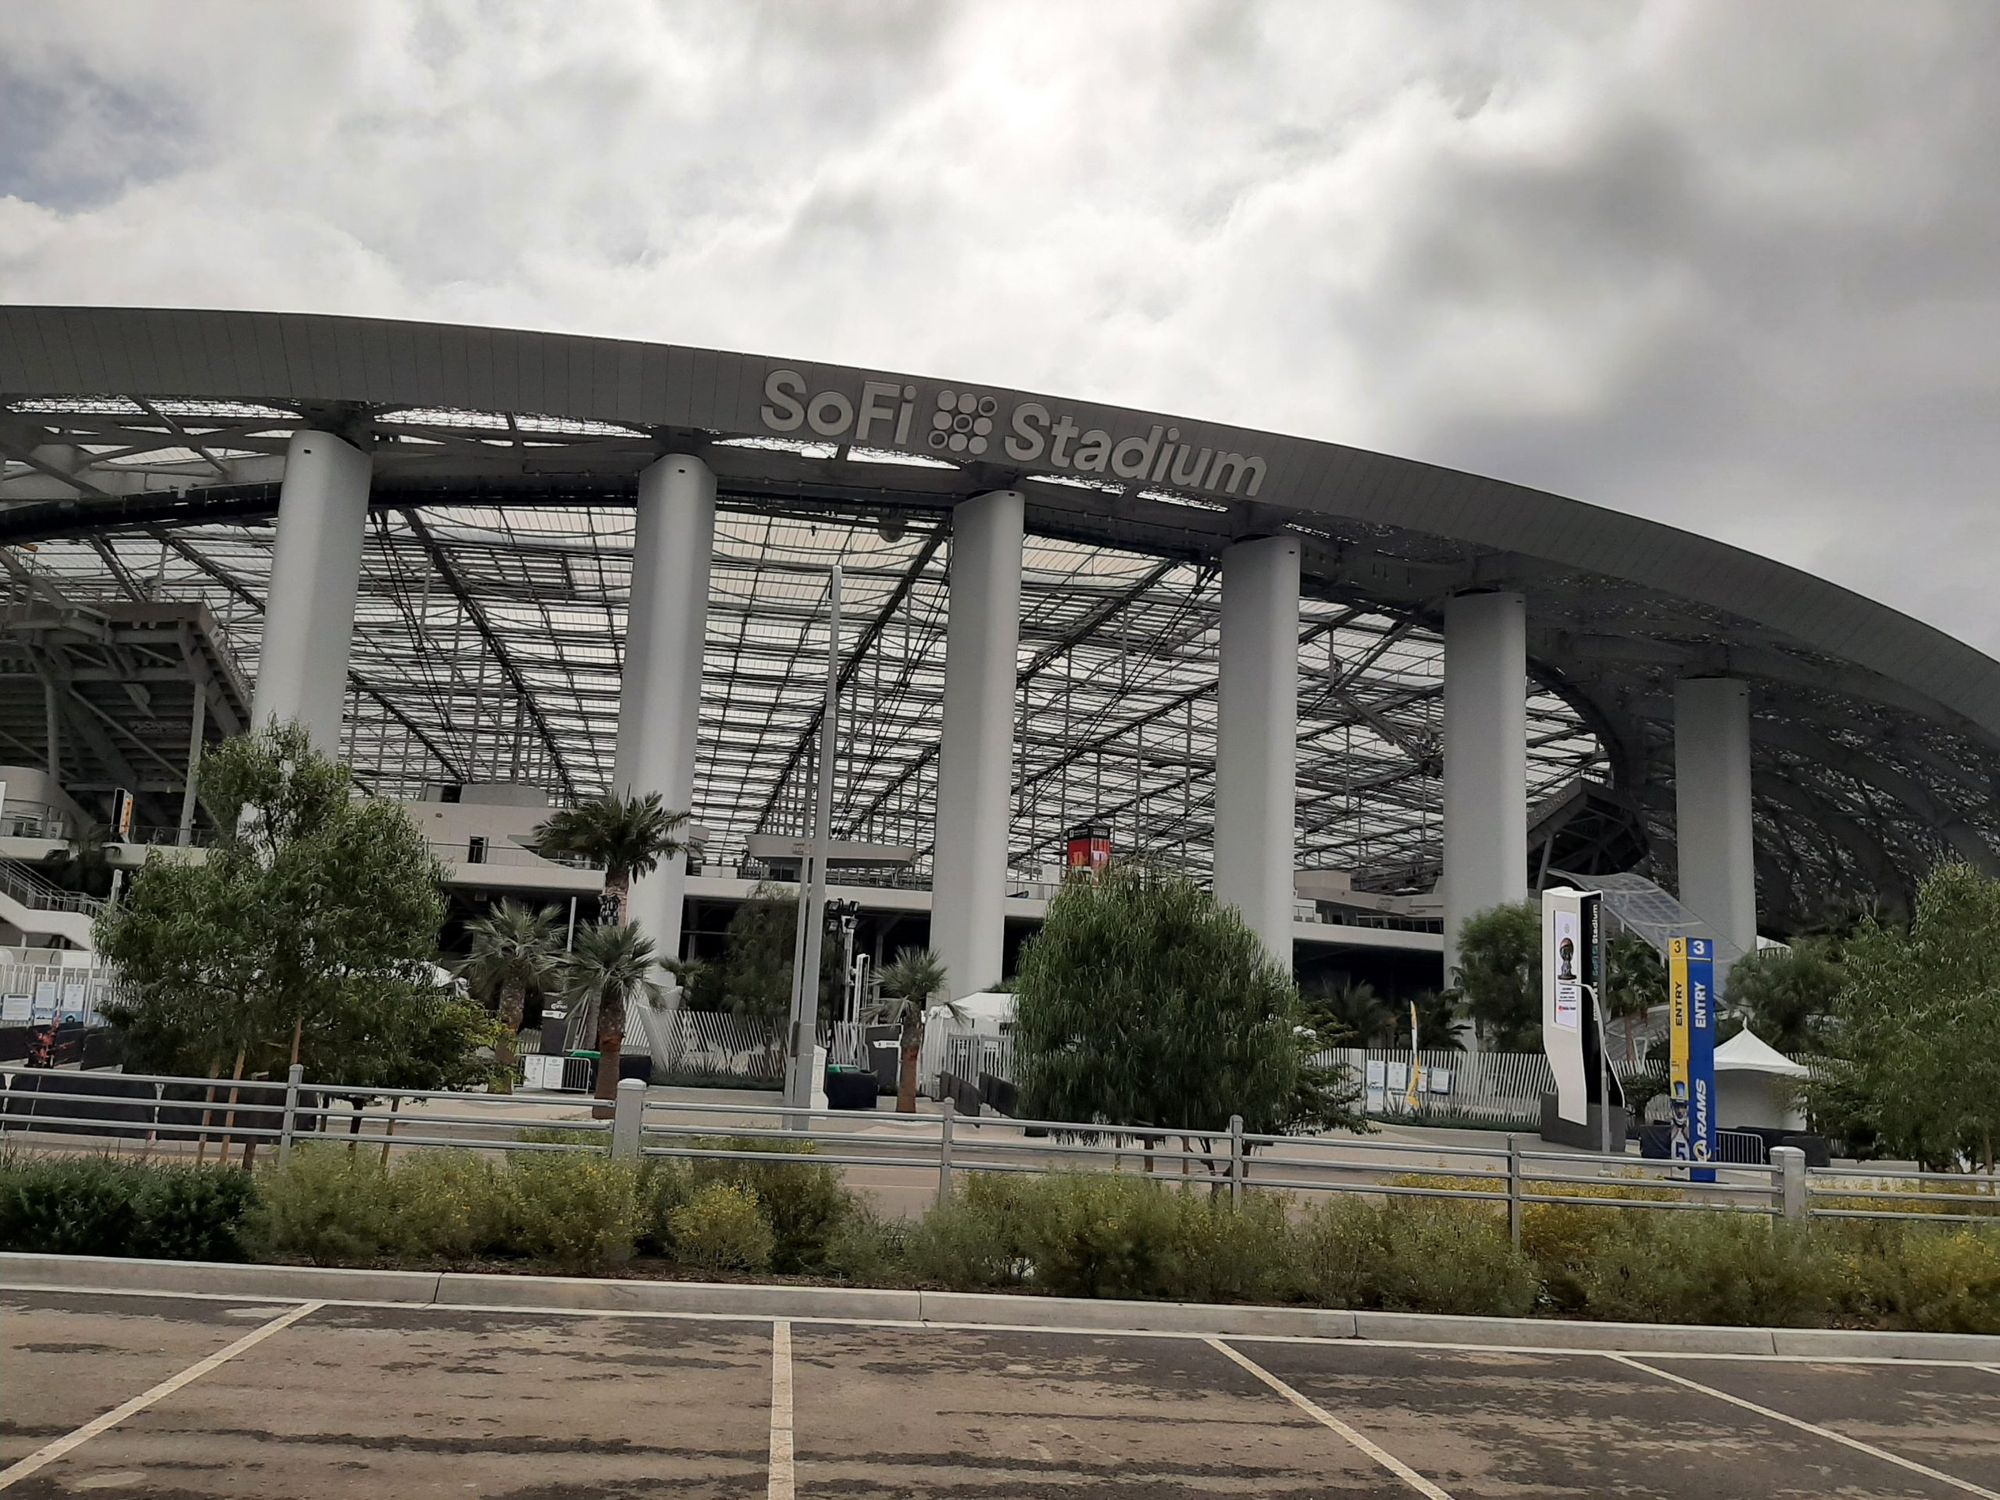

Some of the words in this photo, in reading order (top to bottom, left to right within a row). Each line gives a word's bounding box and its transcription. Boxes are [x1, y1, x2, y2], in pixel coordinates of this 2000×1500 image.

[760, 369, 917, 445] SoFi
[1004, 402, 1267, 497] Stadium
[1591, 904, 1599, 944] Stadium
[1674, 940, 1681, 953] 3
[1693, 940, 1705, 955] 3
[1675, 981, 1683, 1027] ENTRY
[1694, 981, 1707, 1028] ENTRY
[1695, 1078, 1707, 1139] RAMS
